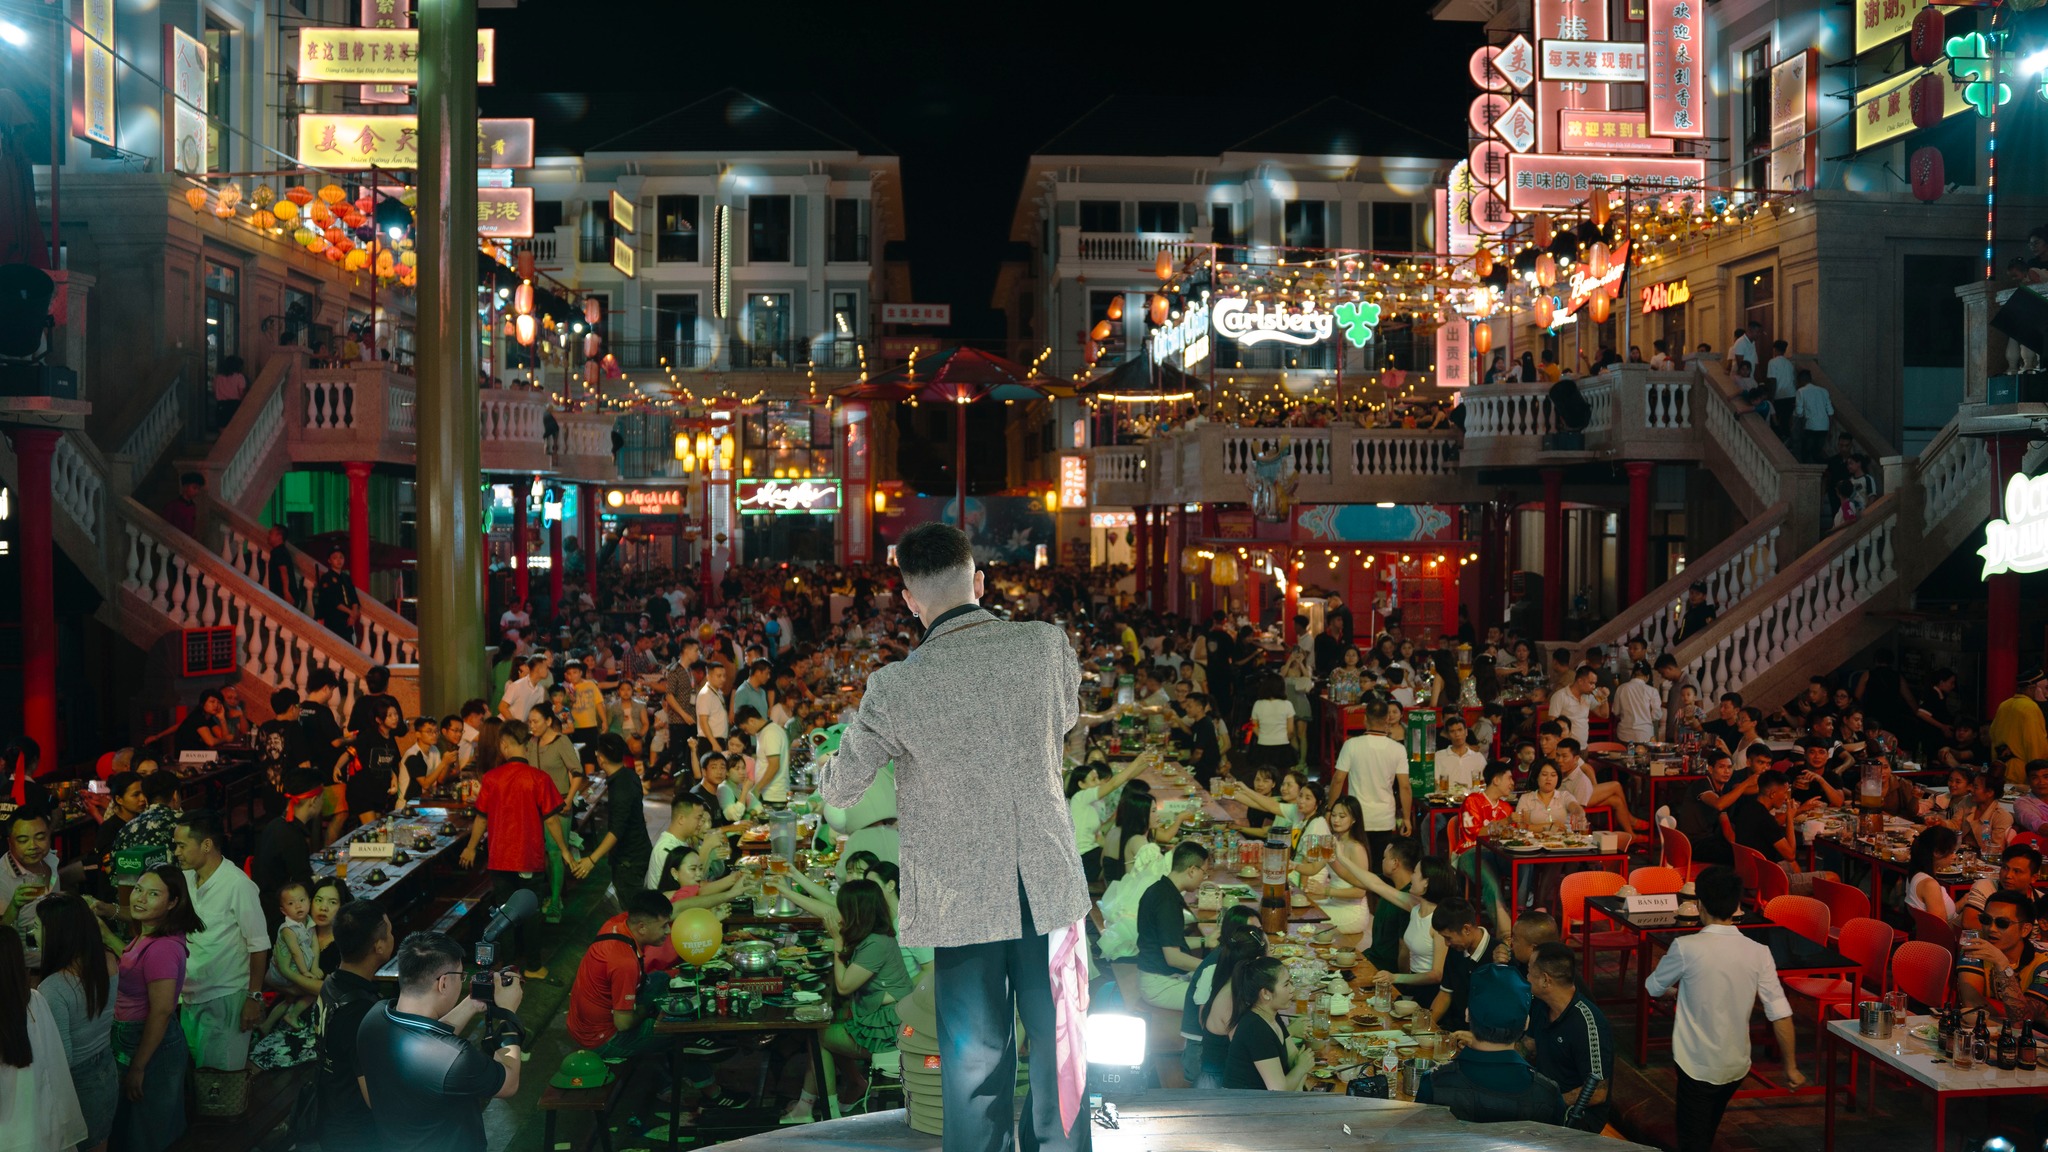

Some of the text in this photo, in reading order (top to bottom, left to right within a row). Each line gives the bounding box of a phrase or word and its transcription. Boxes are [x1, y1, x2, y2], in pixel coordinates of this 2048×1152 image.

[307, 41, 419, 62] 在这里停下来享
[1673, 2, 1693, 129] 欢迎来到香港
[1642, 279, 1691, 314] 24h Club
[1212, 298, 1334, 342] Carlsberg
[682, 940, 713, 949] TRIPLE
[1102, 1073, 1121, 1083] LED
